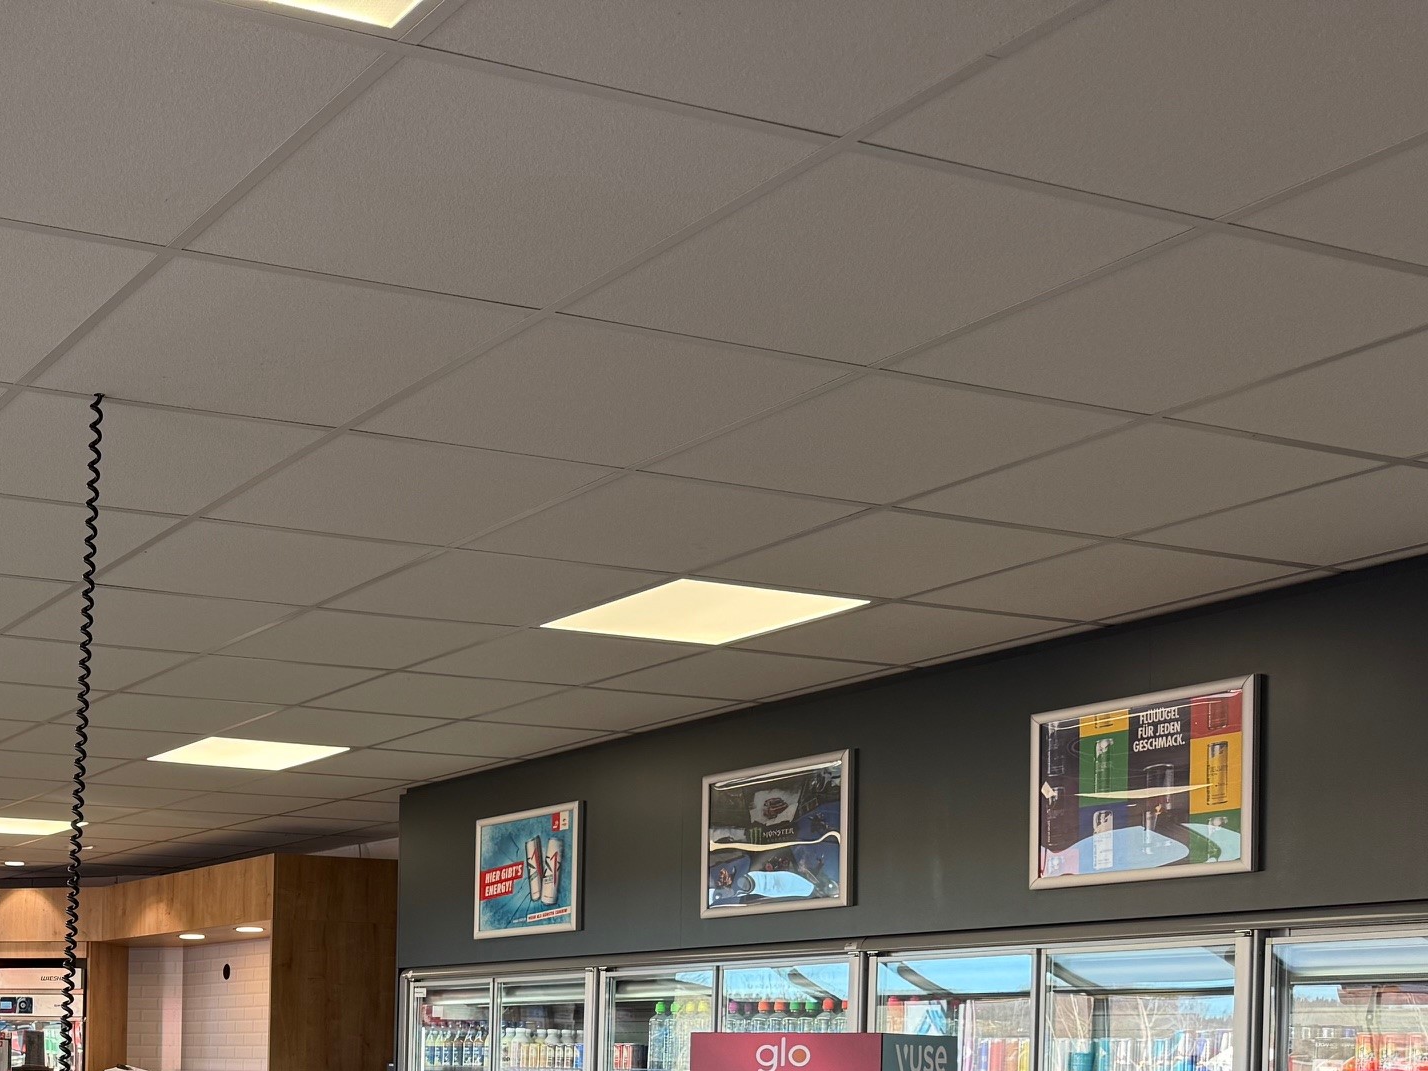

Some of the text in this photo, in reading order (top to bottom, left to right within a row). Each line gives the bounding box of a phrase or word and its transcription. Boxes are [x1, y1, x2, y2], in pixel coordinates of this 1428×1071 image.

[1138, 721, 1181, 738] FÜR JEDEN
[1133, 732, 1186, 753] GESCHMACK.
[485, 870, 501, 884] HIER
[484, 880, 513, 897] ENERGY!
